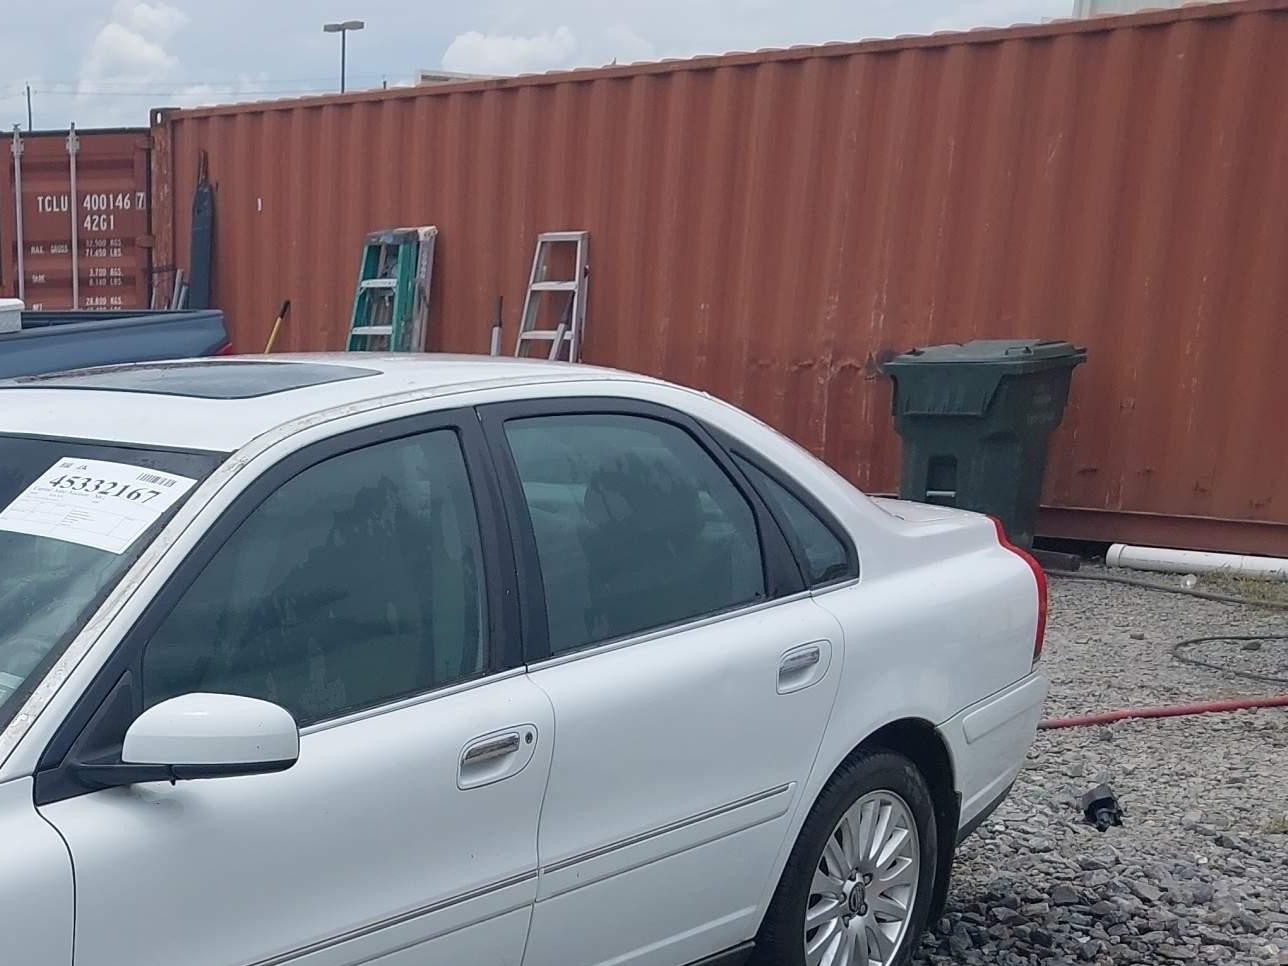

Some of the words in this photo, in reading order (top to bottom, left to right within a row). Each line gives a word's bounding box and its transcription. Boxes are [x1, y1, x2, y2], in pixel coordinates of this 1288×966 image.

[37, 196, 68, 212] TCLU
[83, 194, 131, 210] 400146
[136, 192, 145, 209] 7
[83, 215, 114, 231] 42G1
[49, 474, 161, 504] 45332167
